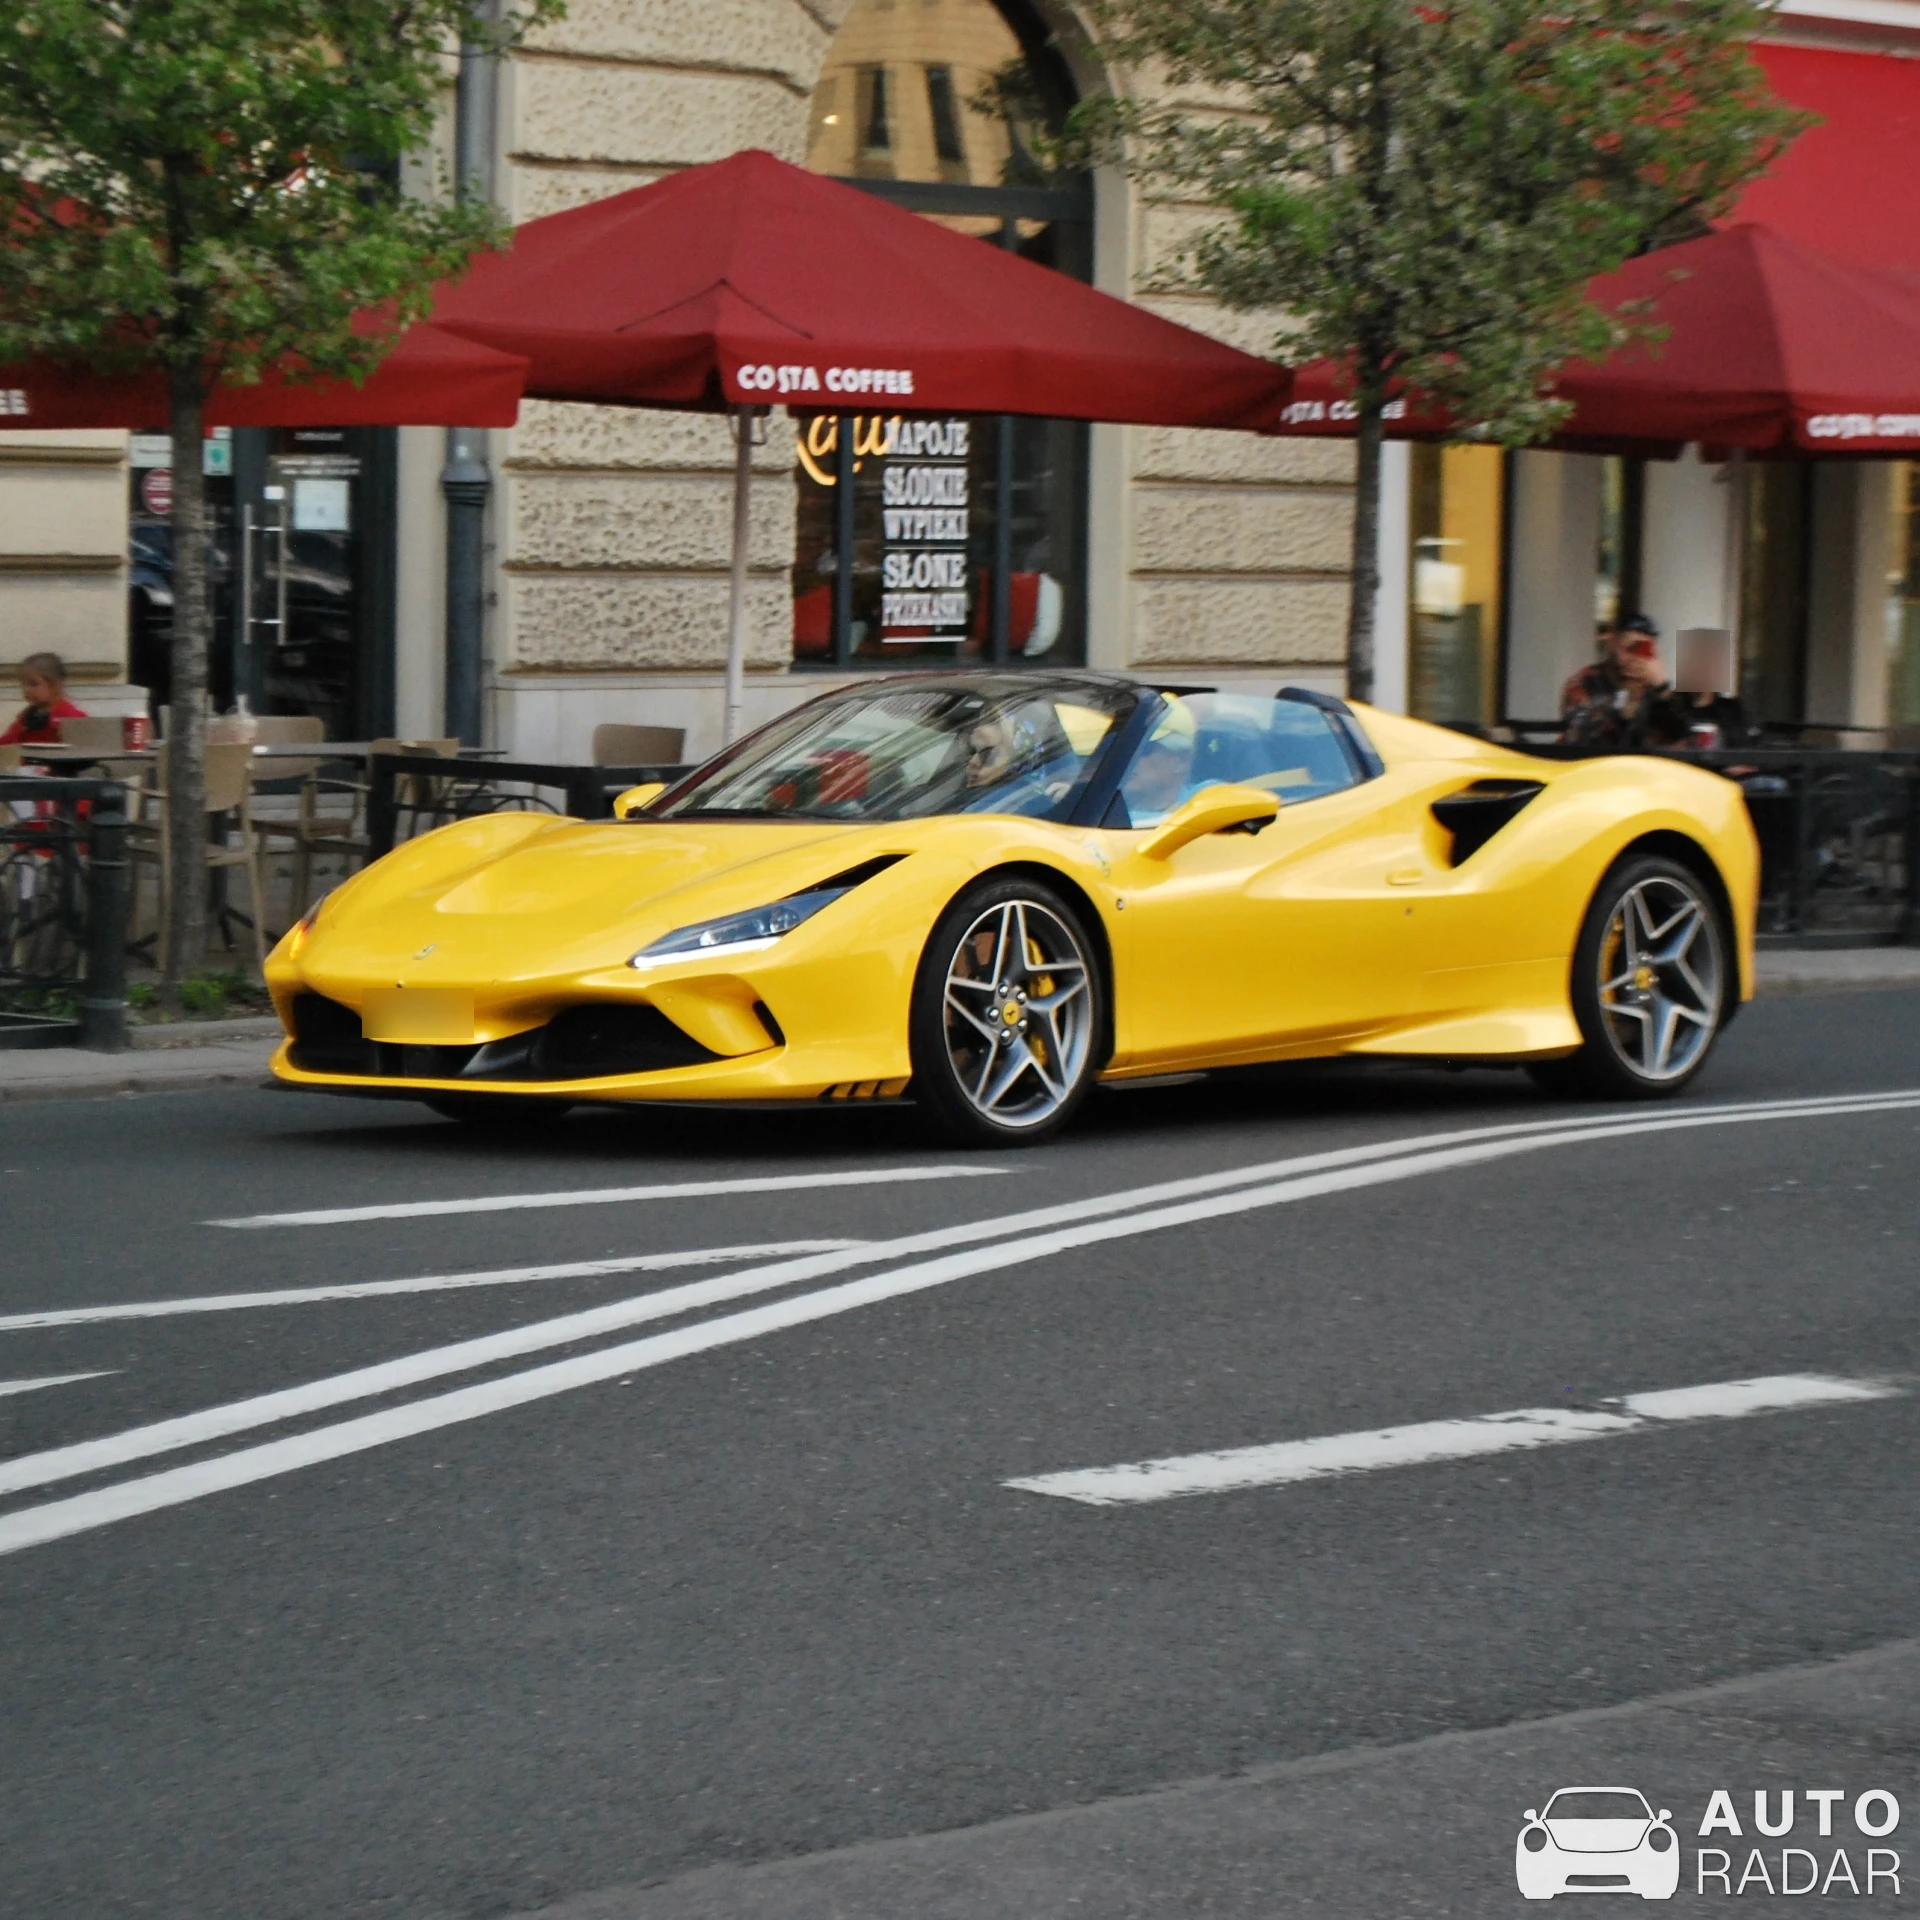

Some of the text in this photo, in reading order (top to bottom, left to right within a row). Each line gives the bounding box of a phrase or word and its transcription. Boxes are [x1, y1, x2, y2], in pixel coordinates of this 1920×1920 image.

[736, 363, 914, 395] COSTA COFFEE
[884, 420, 970, 456] NAPOJE
[882, 508, 970, 540] WYPIEKI
[882, 552, 968, 589] SŁONE
